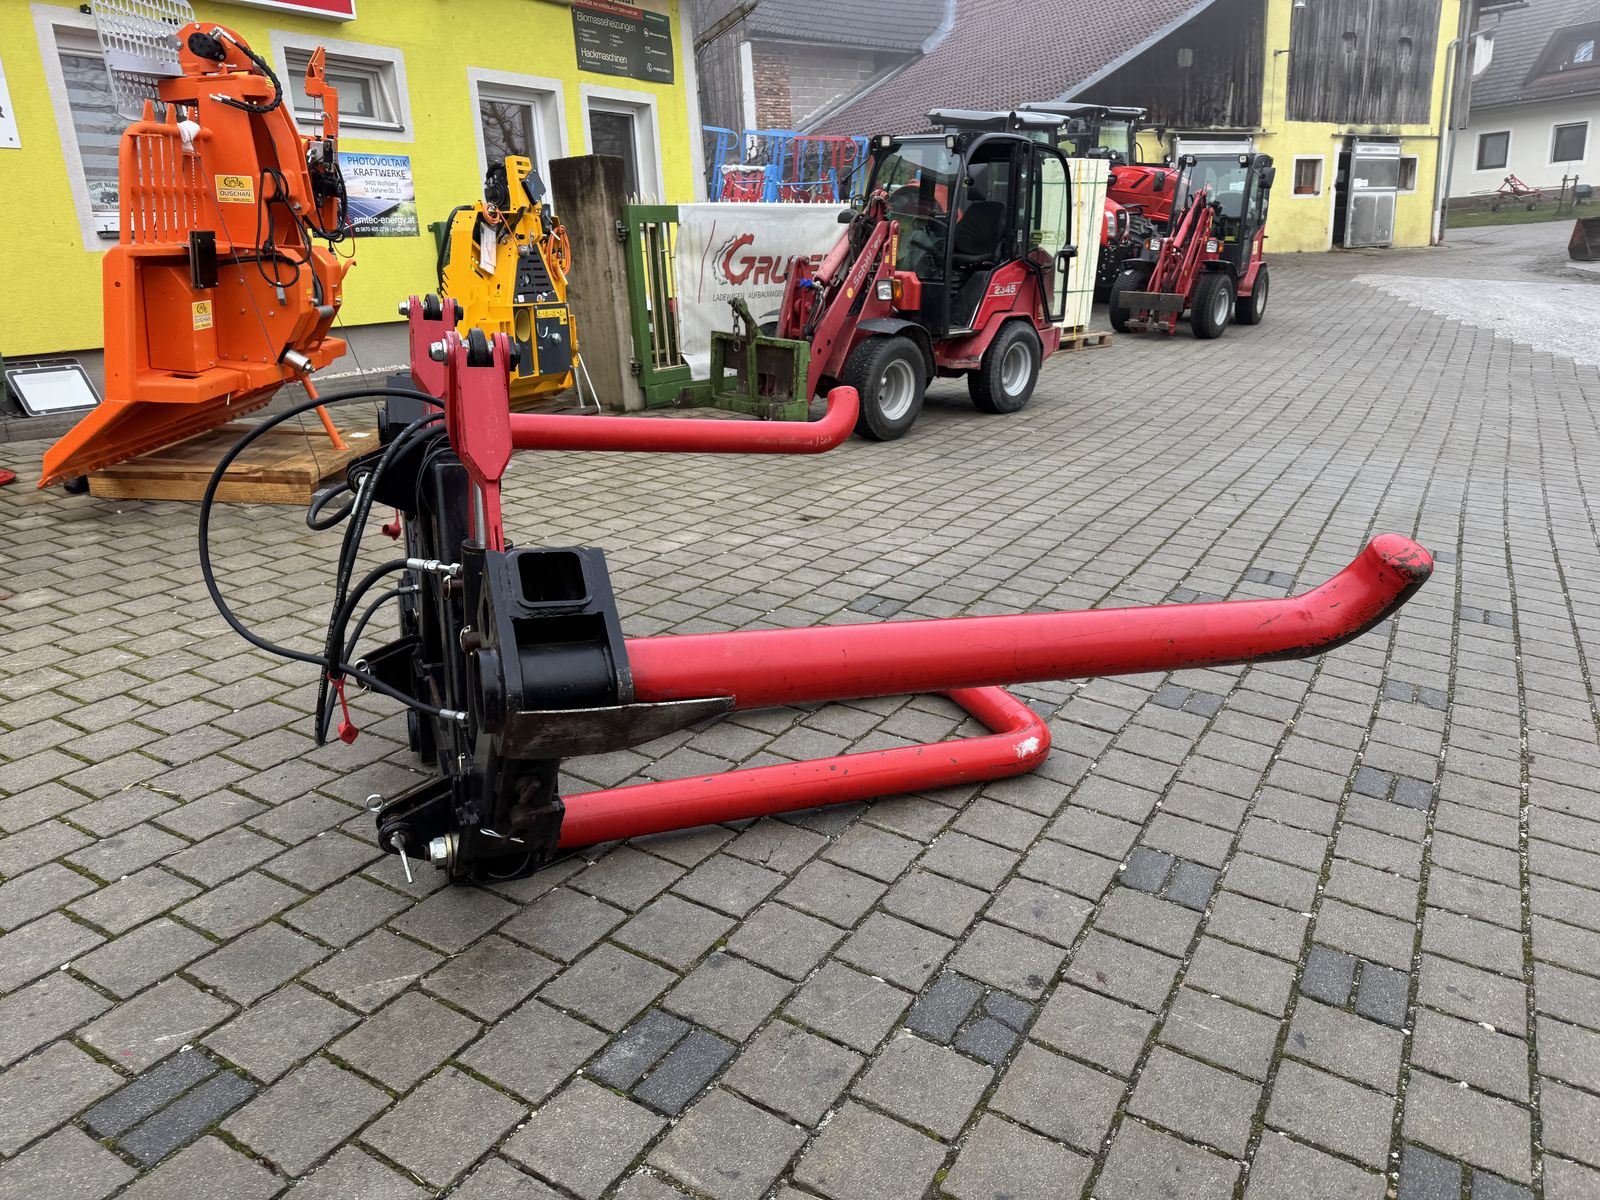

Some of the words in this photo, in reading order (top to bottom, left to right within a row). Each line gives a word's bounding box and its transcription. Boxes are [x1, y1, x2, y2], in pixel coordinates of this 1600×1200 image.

[576, 11, 637, 33] Biomasseheizungen
[580, 47, 628, 64] Hackmaschinen
[347, 156, 408, 168] PHOTOVOLTAIK
[353, 167, 406, 178] KRAFTWERKE
[353, 216, 415, 226] amtec-energy.at
[994, 284, 1016, 295] 2345
